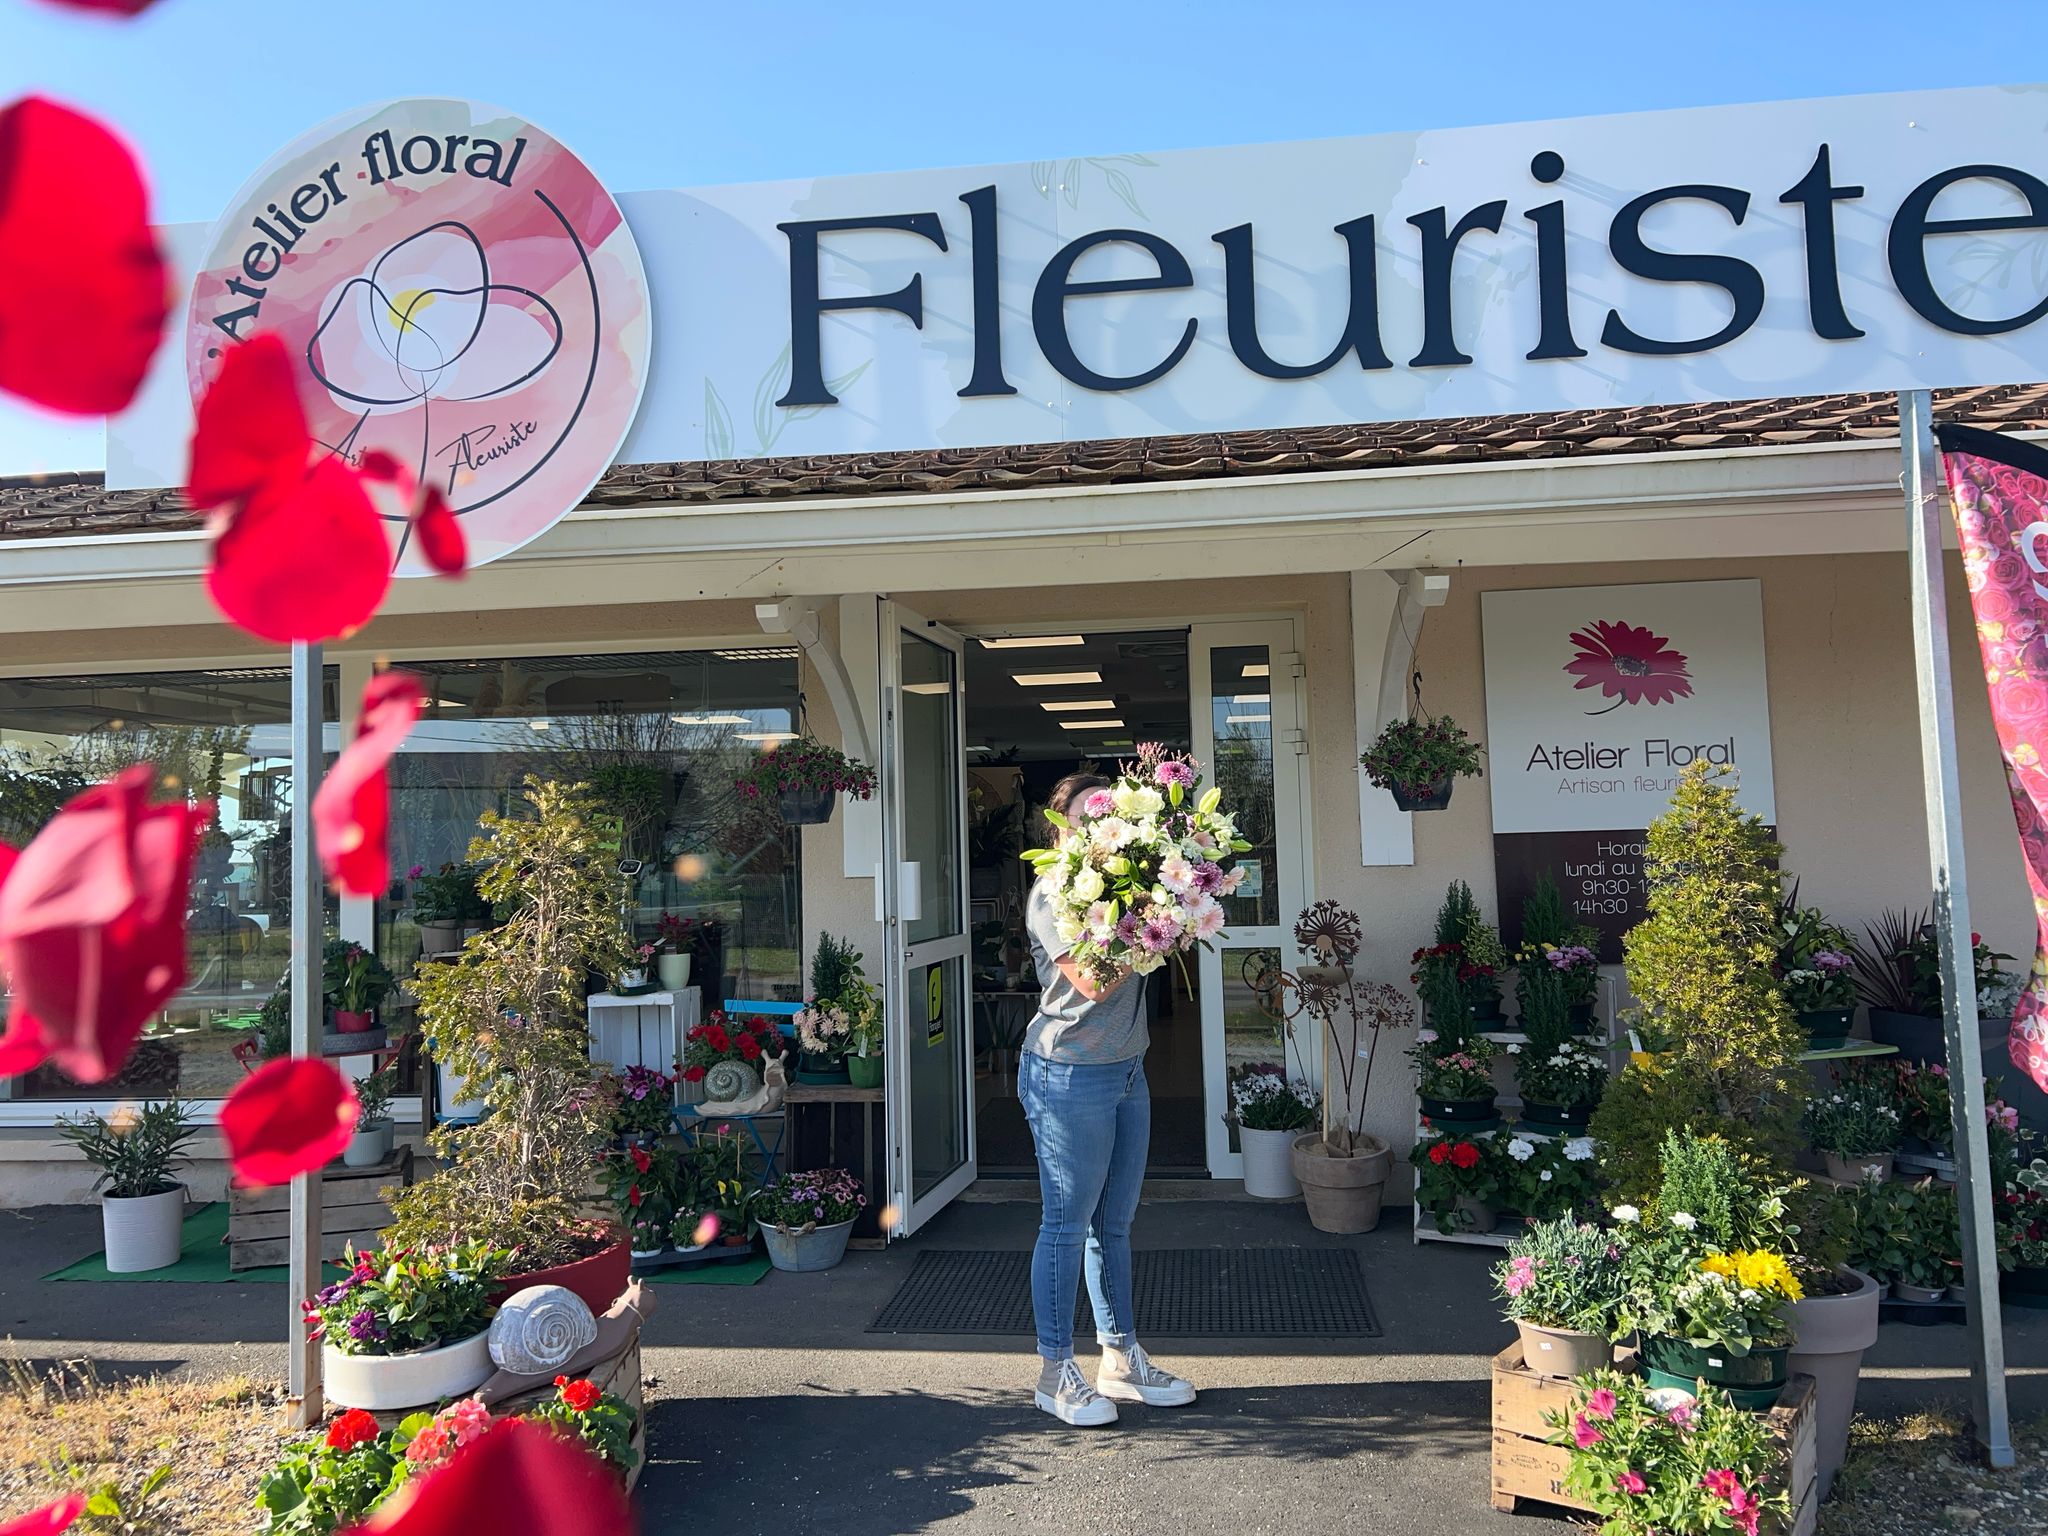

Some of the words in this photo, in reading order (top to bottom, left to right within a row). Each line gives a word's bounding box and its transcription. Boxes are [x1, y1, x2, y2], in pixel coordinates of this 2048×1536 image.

[207, 161, 348, 372] 'Atelier
[361, 129, 527, 186] floral
[775, 142, 2048, 407] Fleuriste
[435, 421, 537, 496] Fleuriste
[1526, 742, 1630, 771] Atelier
[1645, 737, 1735, 767] Floral
[1558, 777, 1625, 795] Artisan
[1565, 861, 1605, 877] lundi
[1612, 863, 1635, 875] au
[1572, 898, 1628, 915] 14h30
